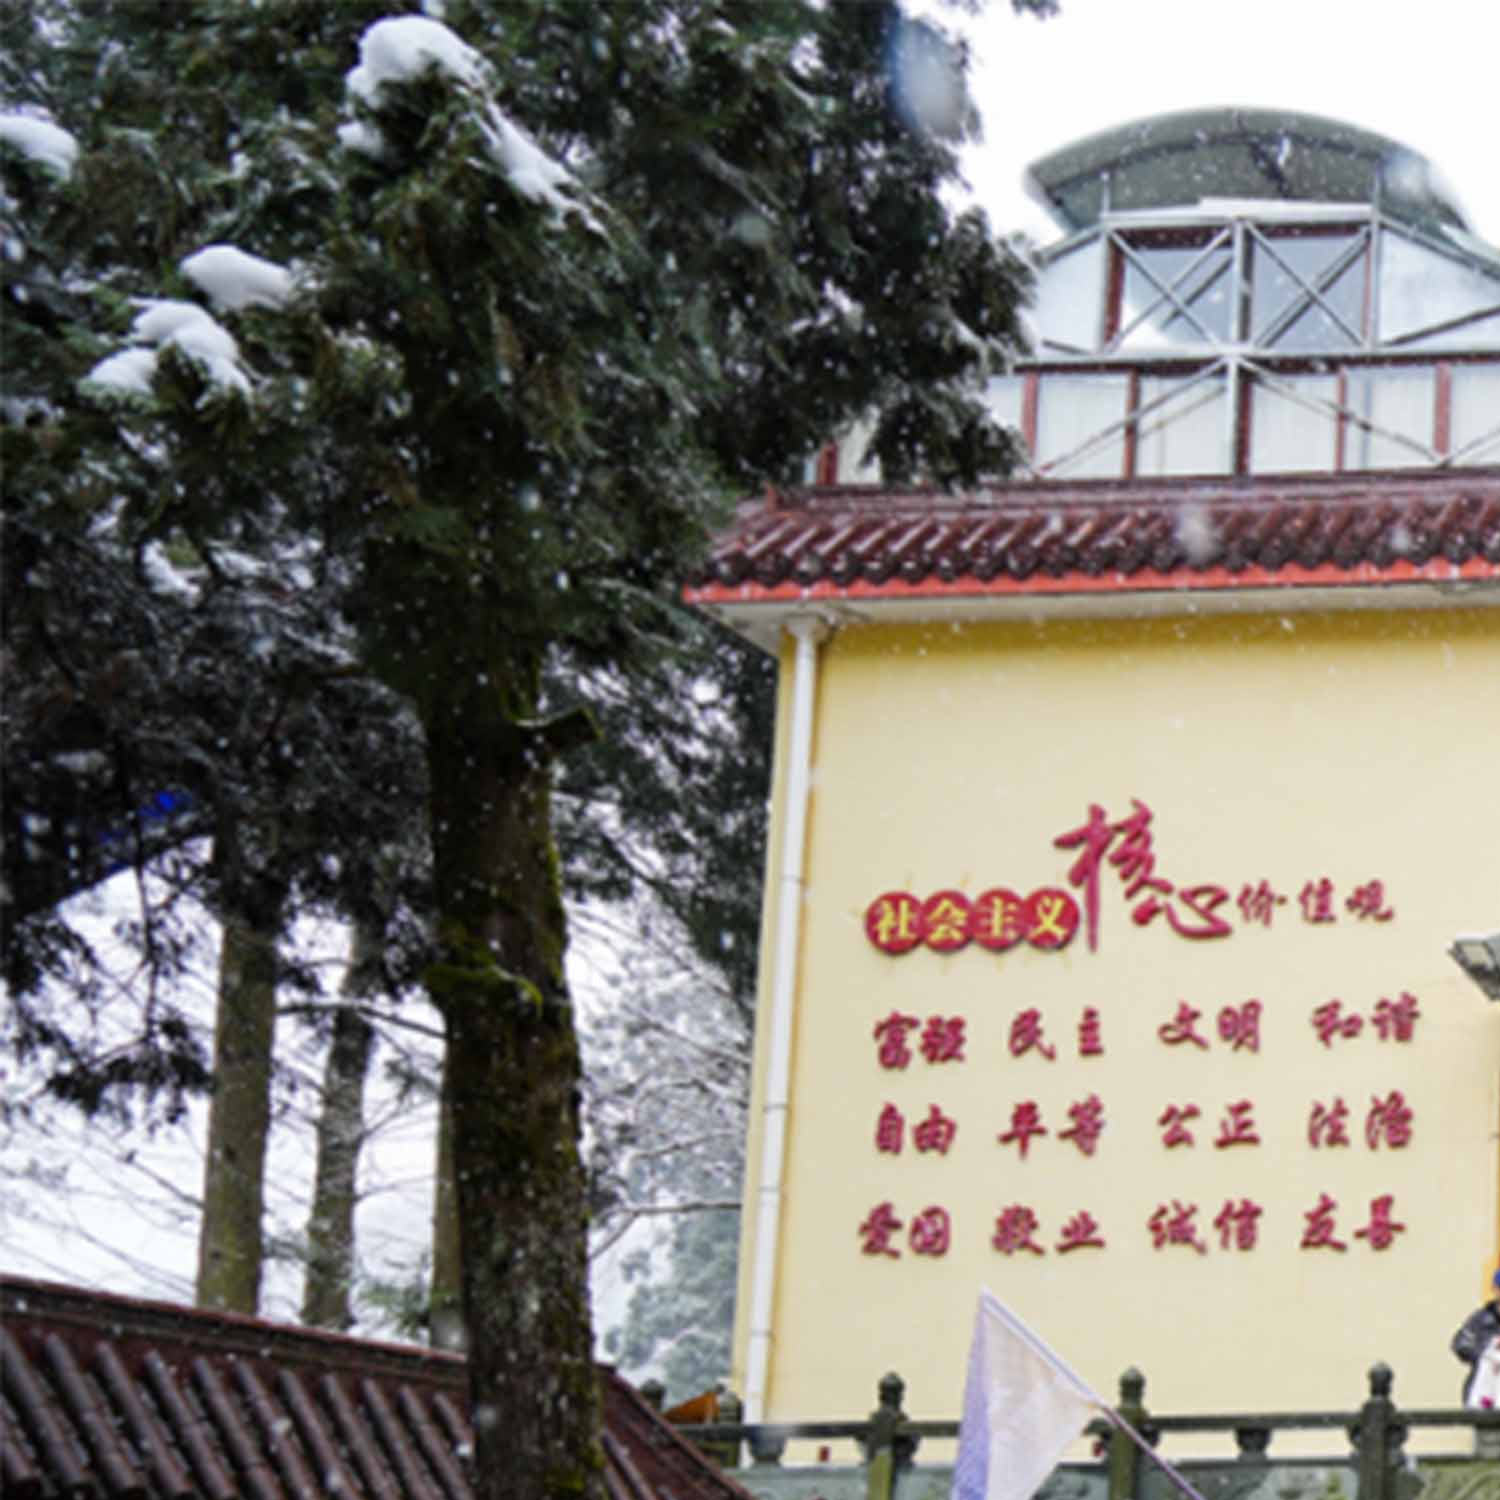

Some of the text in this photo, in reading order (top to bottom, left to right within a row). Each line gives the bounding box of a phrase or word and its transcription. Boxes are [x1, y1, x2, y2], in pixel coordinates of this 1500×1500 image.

[873, 993, 1420, 1070] 富强 民主 文明 和谐
[874, 1090, 1415, 1160] 自由 平等 公正 法治
[858, 1194, 1405, 1259] 爱国 敬业 诚信 友善
